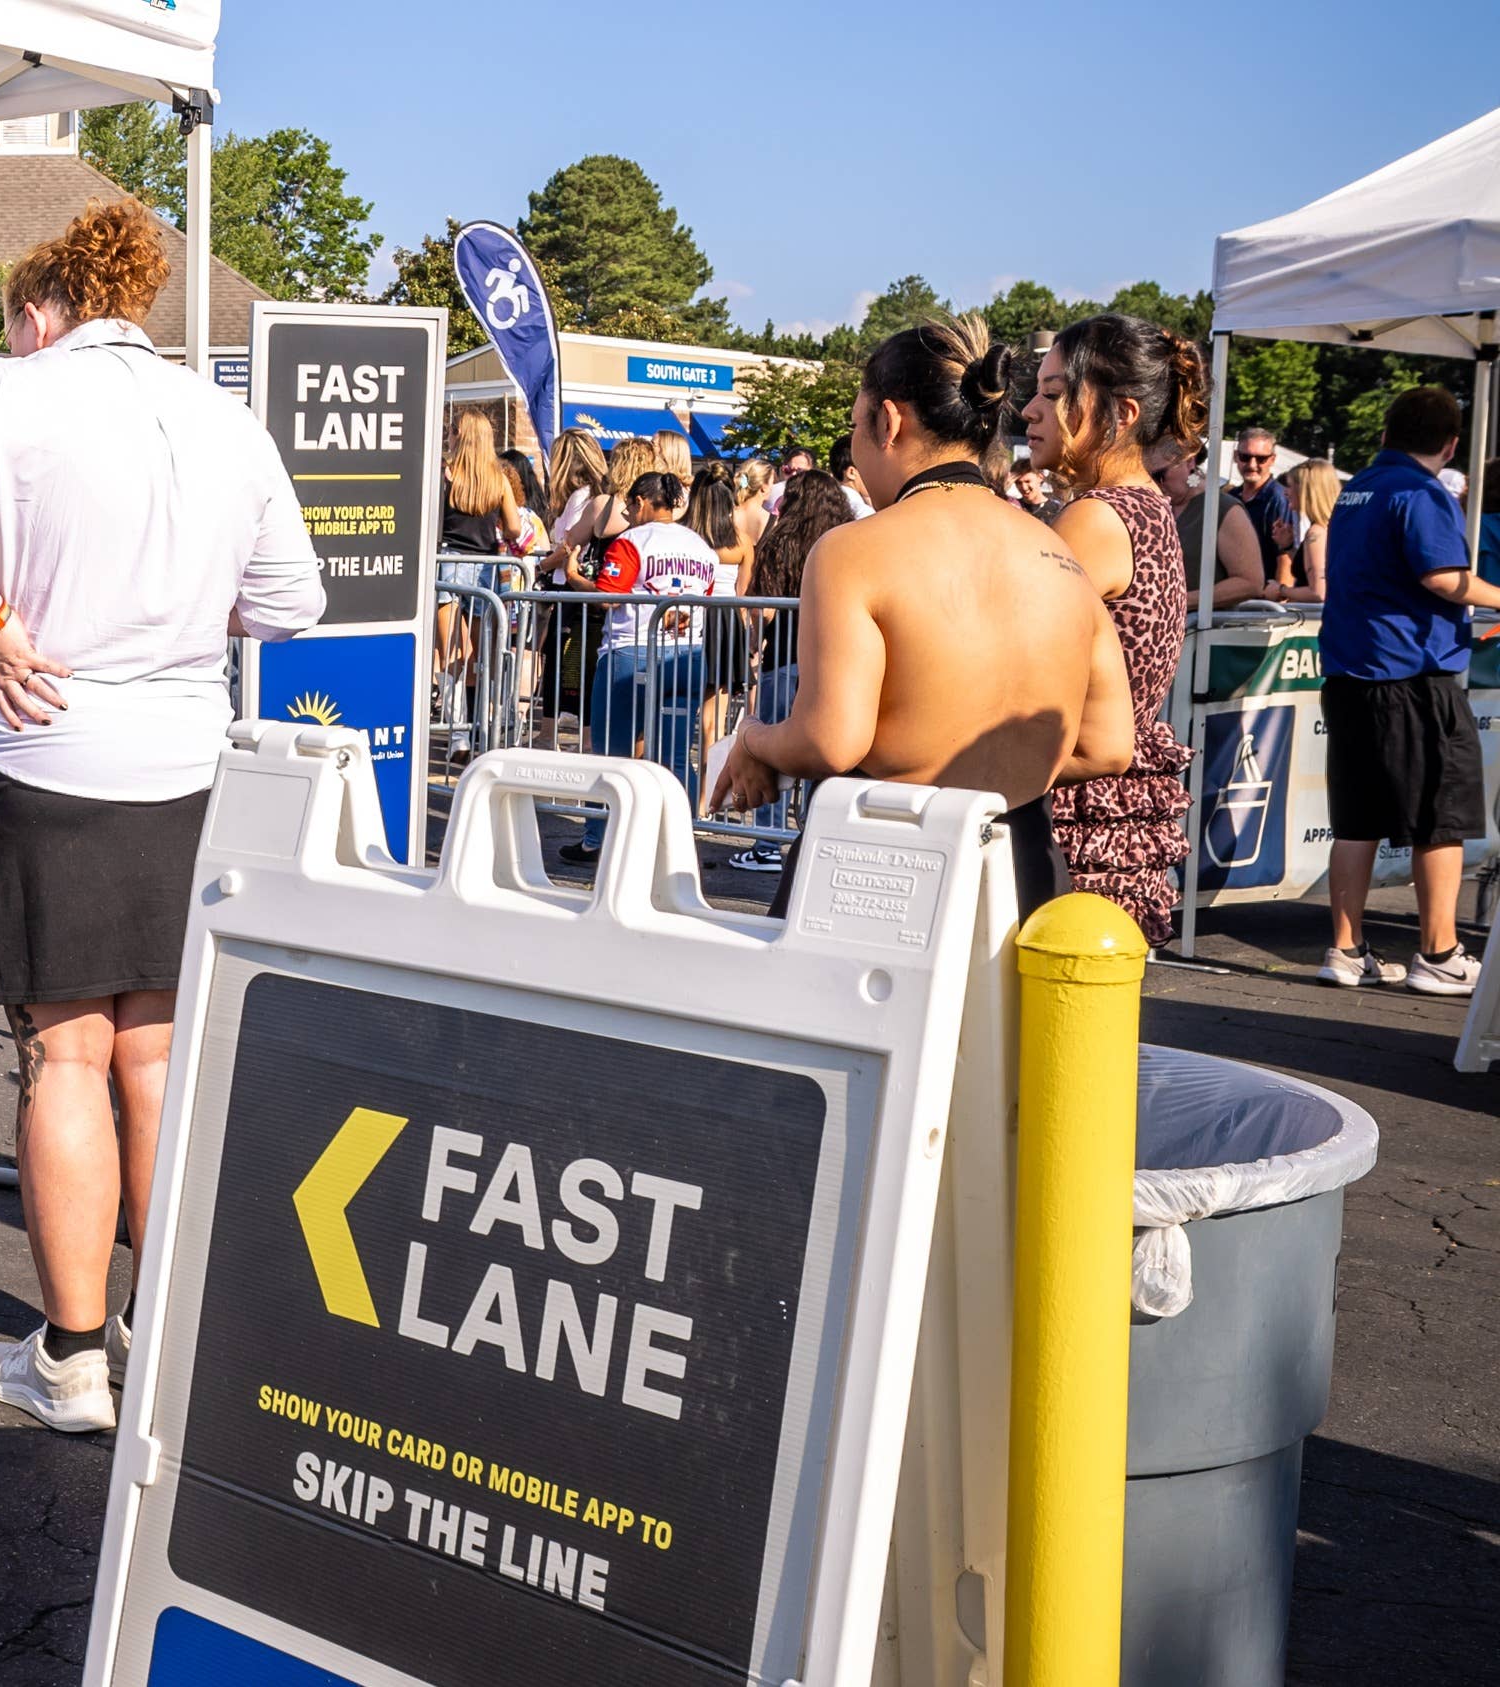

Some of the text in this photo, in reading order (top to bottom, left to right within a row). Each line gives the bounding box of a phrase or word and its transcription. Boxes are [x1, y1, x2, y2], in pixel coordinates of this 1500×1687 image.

[219, 365, 235, 373] WILL
[646, 363, 717, 384] SOUTH GATE 3
[297, 363, 405, 403] FAST
[294, 412, 403, 450] LANE
[333, 505, 364, 520] YOUR
[365, 505, 395, 519] CARD
[314, 521, 357, 535] MOBILE
[358, 521, 380, 535] APP
[381, 520, 395, 534] TO
[328, 556, 360, 577] THE
[363, 555, 404, 576] LANE
[645, 555, 715, 583] DOMINICANA
[386, 750, 405, 759] Union
[889, 851, 942, 873] Deluxe
[422, 1125, 703, 1282] FAST
[397, 1241, 693, 1421] LANE
[257, 1384, 673, 1551] SHOW YOUR CARD OR MOBILE APP TO
[293, 1451, 610, 1613] SKIP THE LINE
